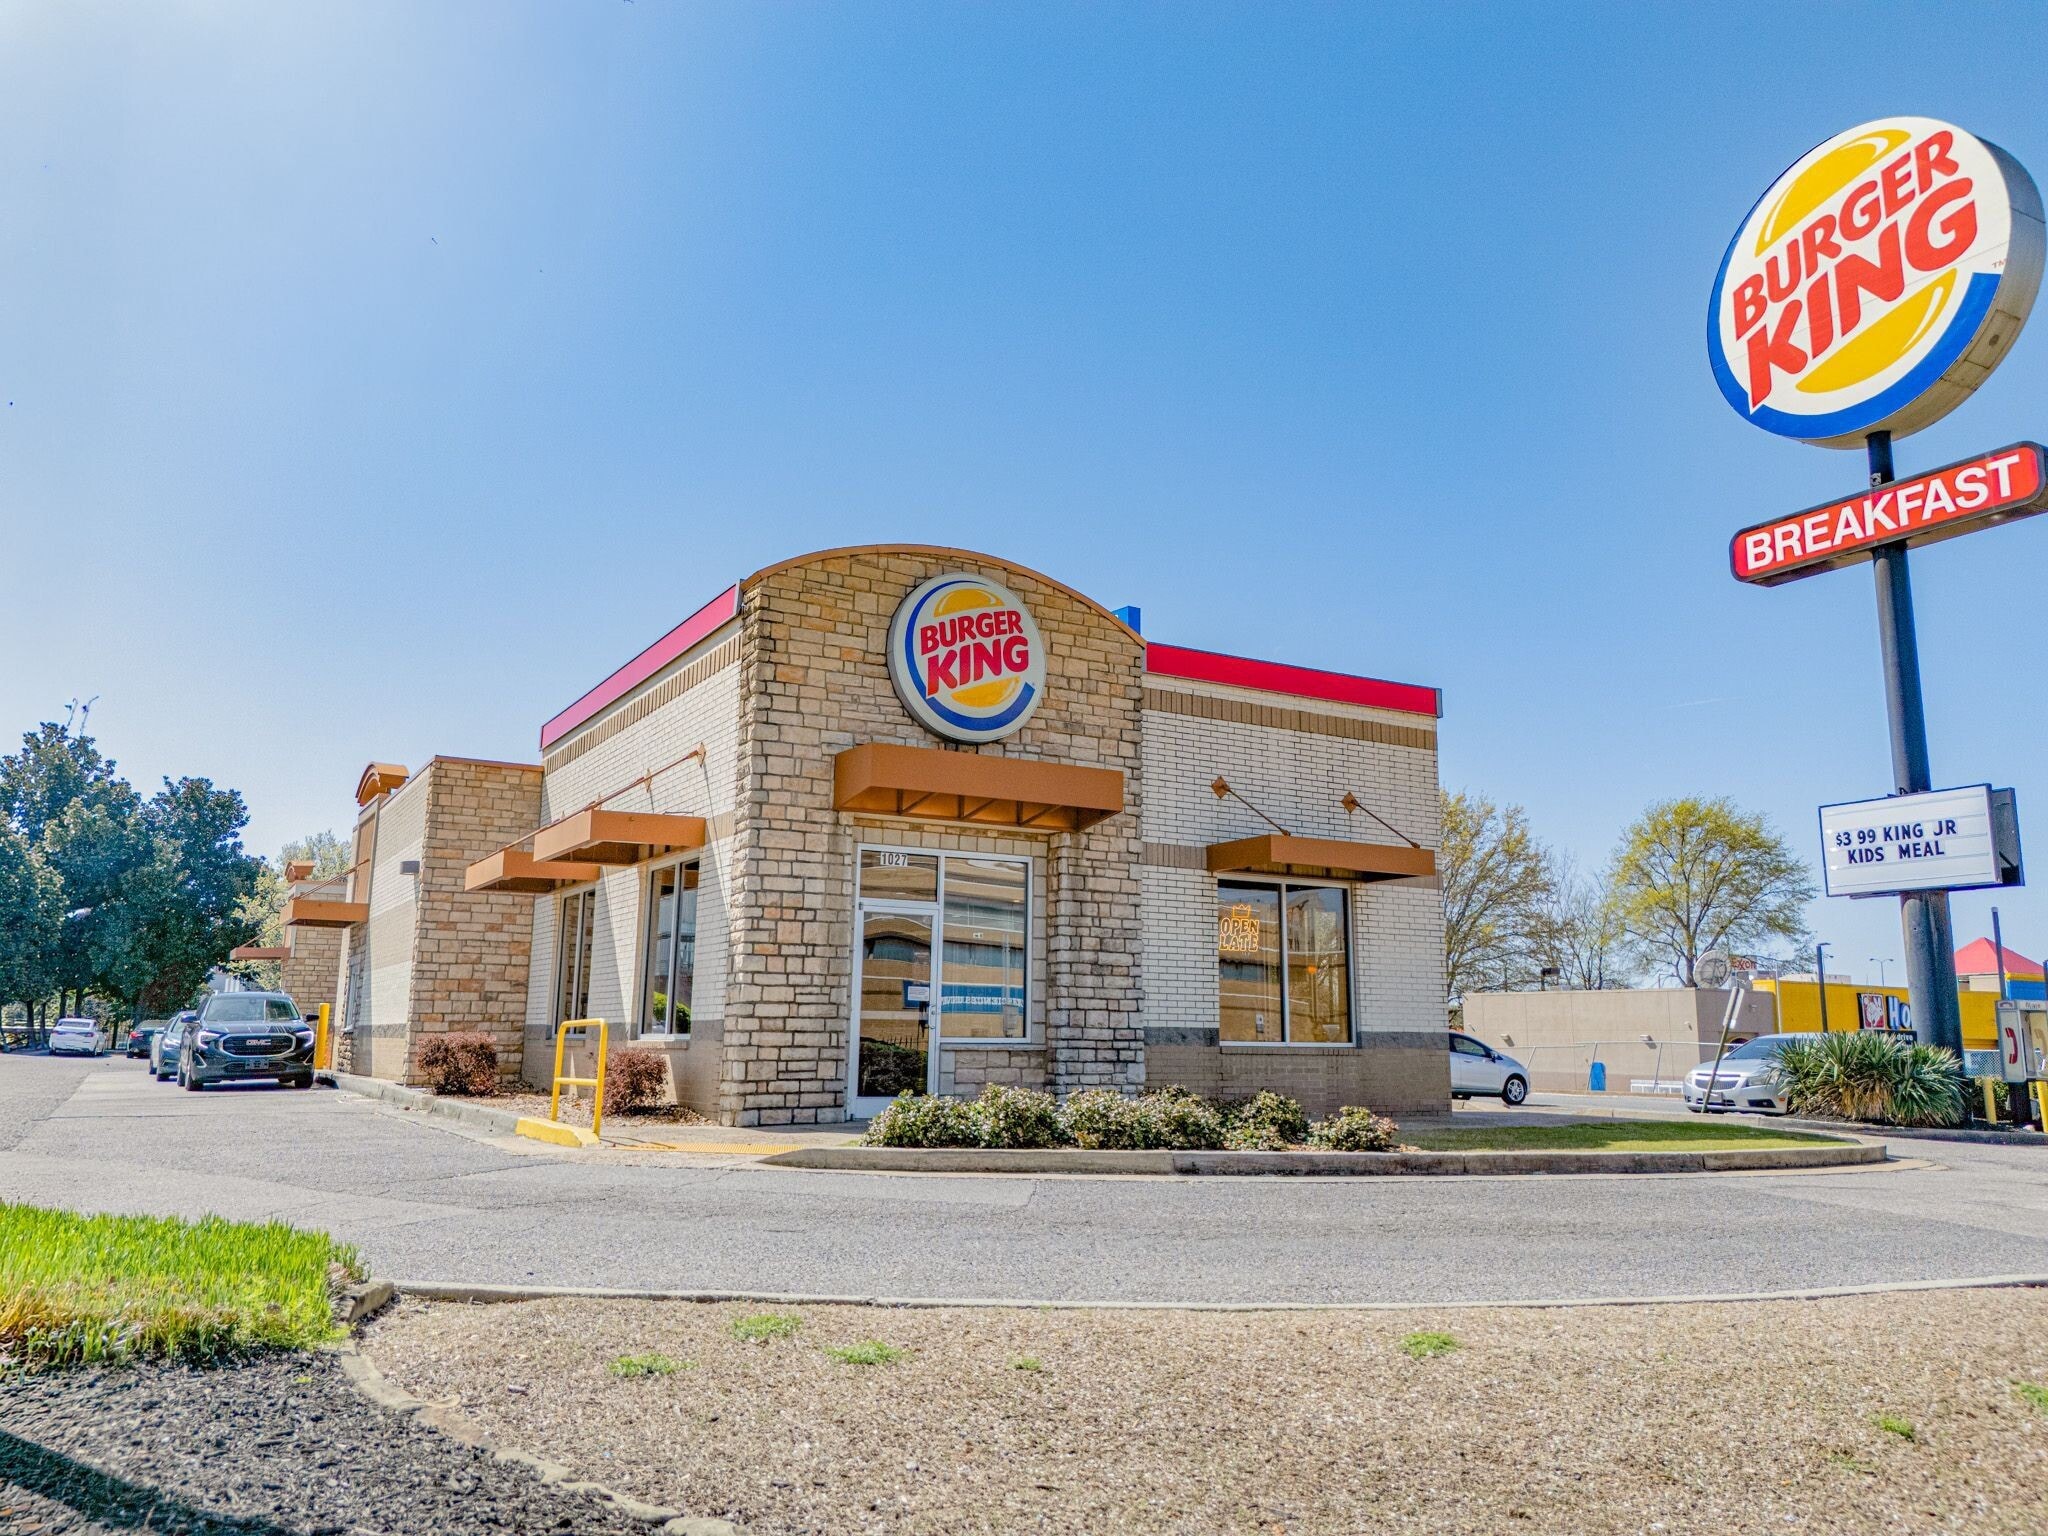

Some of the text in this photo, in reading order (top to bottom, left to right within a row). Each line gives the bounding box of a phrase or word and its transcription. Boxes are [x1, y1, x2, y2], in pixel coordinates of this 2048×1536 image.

[1732, 130, 1959, 342] BURGER
[1747, 177, 1978, 409] KING
[1745, 454, 2020, 571] BREAKFAST
[920, 610, 1023, 656] BURGER
[926, 635, 1029, 696] KING
[1836, 820, 1956, 847] $3 99 KING JR
[882, 853, 906, 866] 1027
[1848, 841, 1944, 864] KIDS MEAL
[1219, 935, 1258, 952] LATE
[1221, 917, 1259, 936] OPEN
